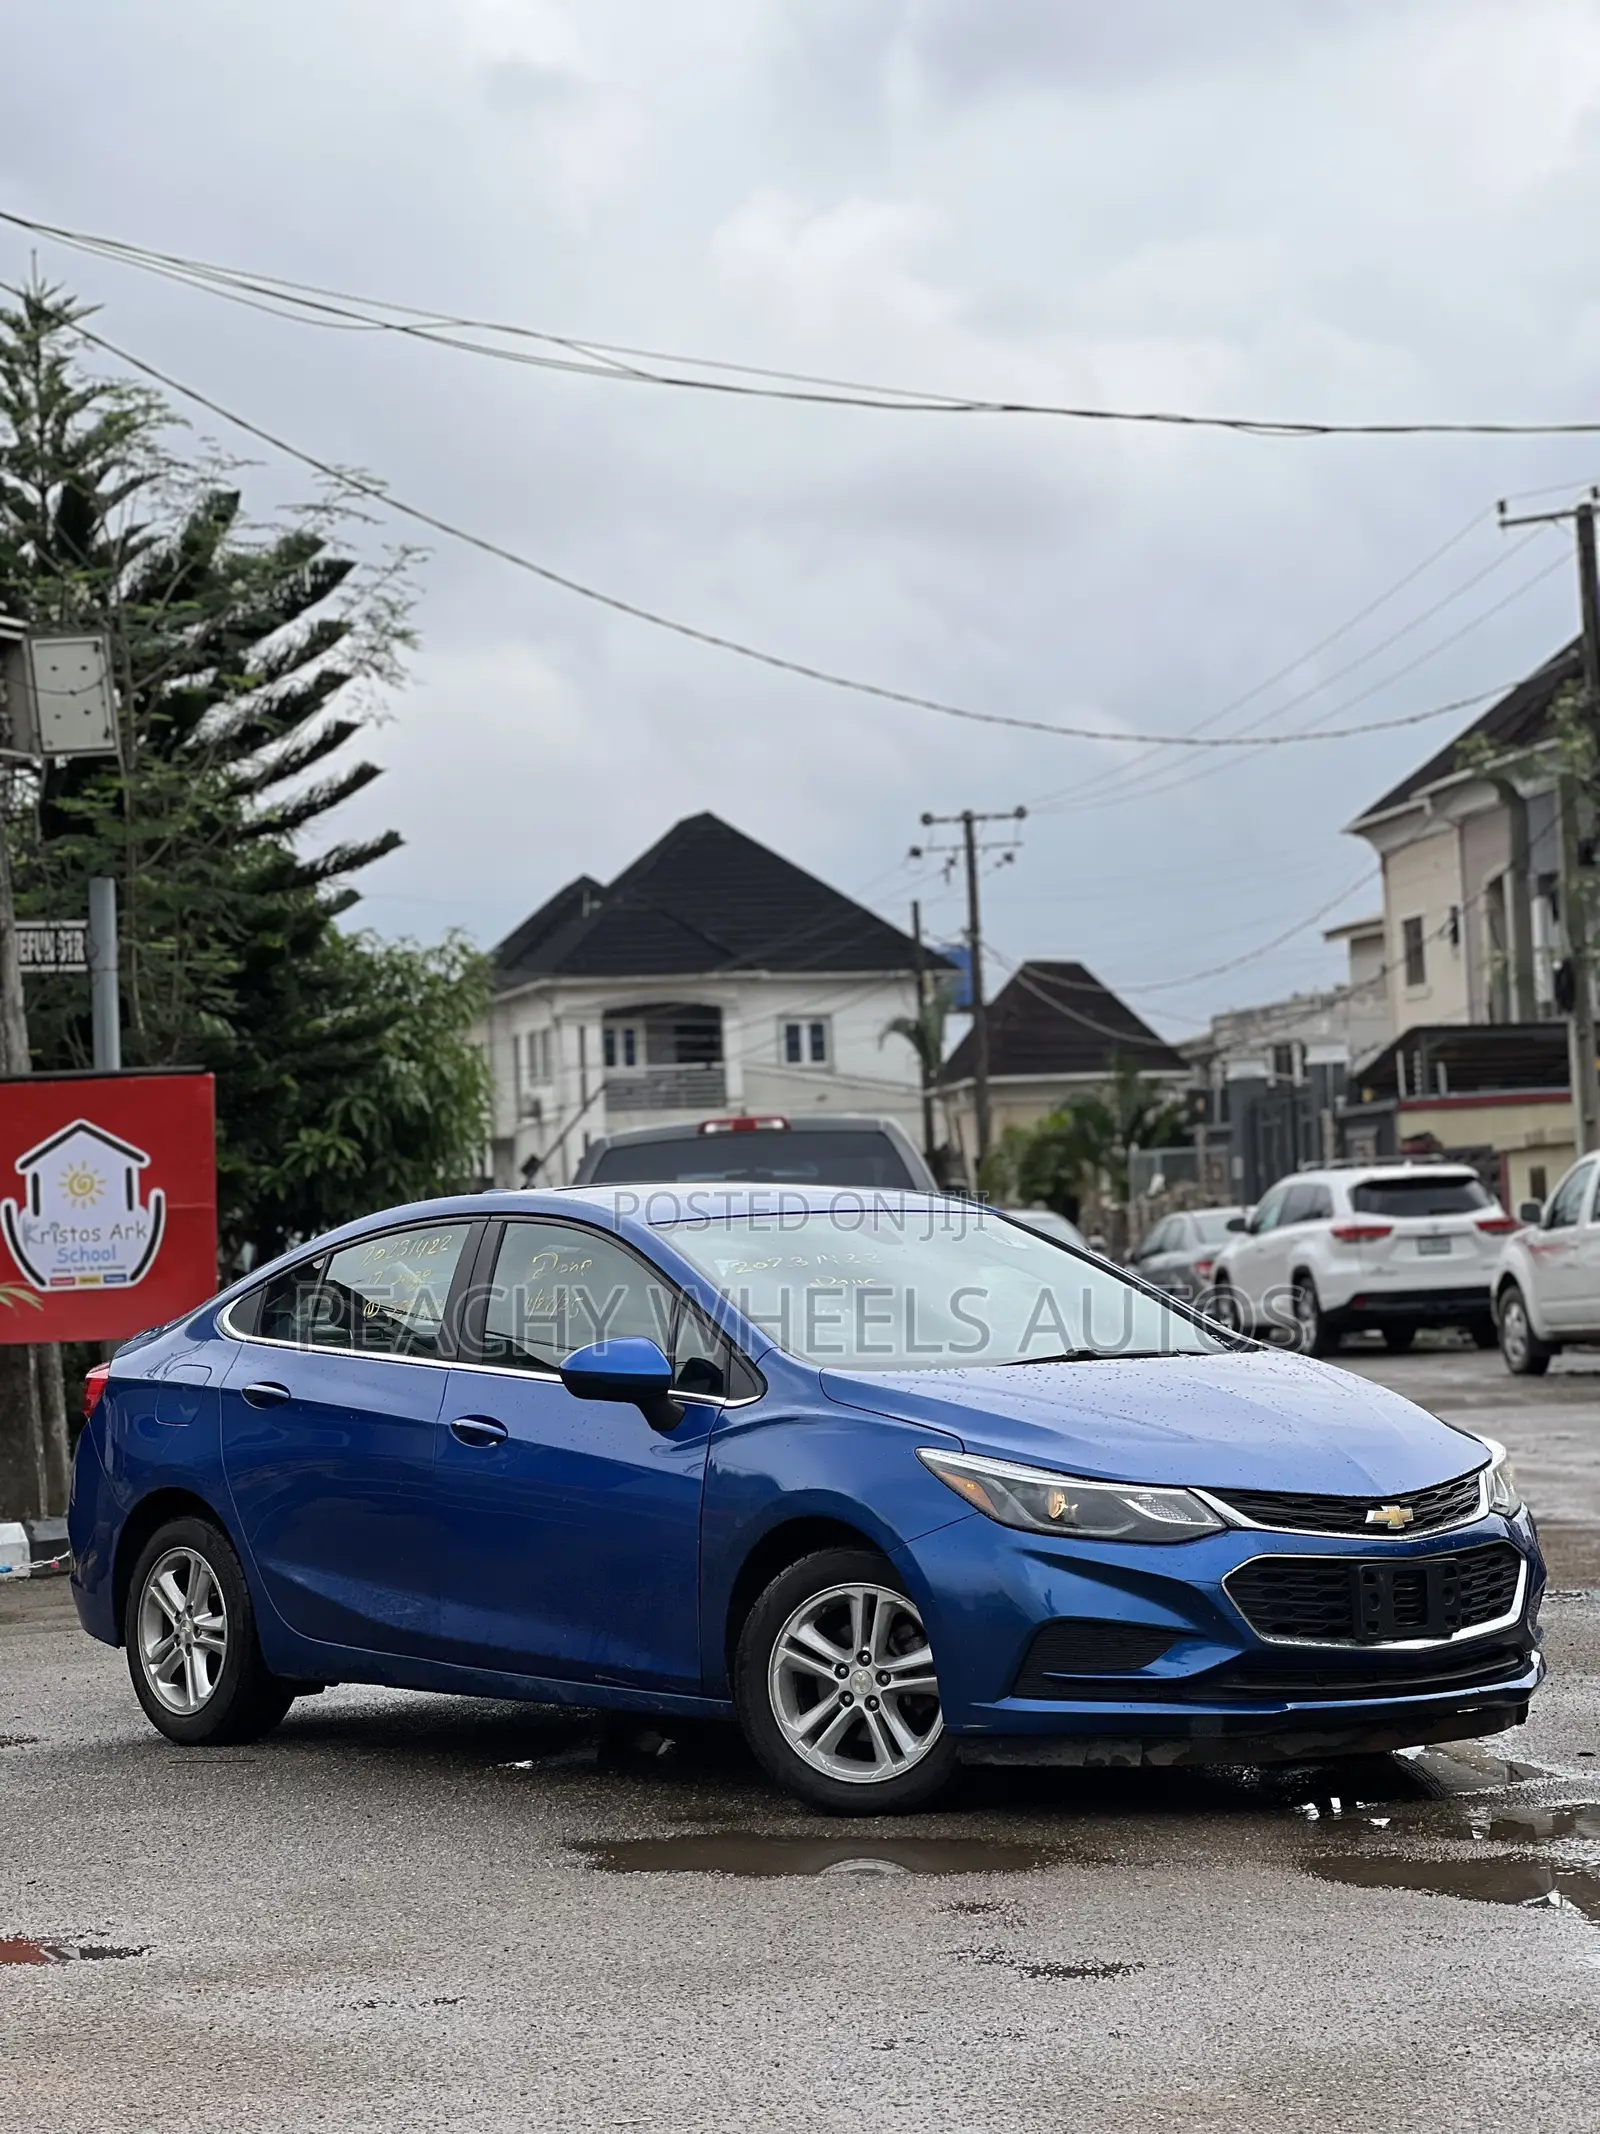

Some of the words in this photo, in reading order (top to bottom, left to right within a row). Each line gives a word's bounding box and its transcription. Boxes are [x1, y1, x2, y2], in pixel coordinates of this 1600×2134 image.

[57, 930, 85, 962] STR
[23, 1219, 101, 1245] Kristos
[109, 1220, 148, 1241] Ark
[57, 1244, 117, 1263] School
